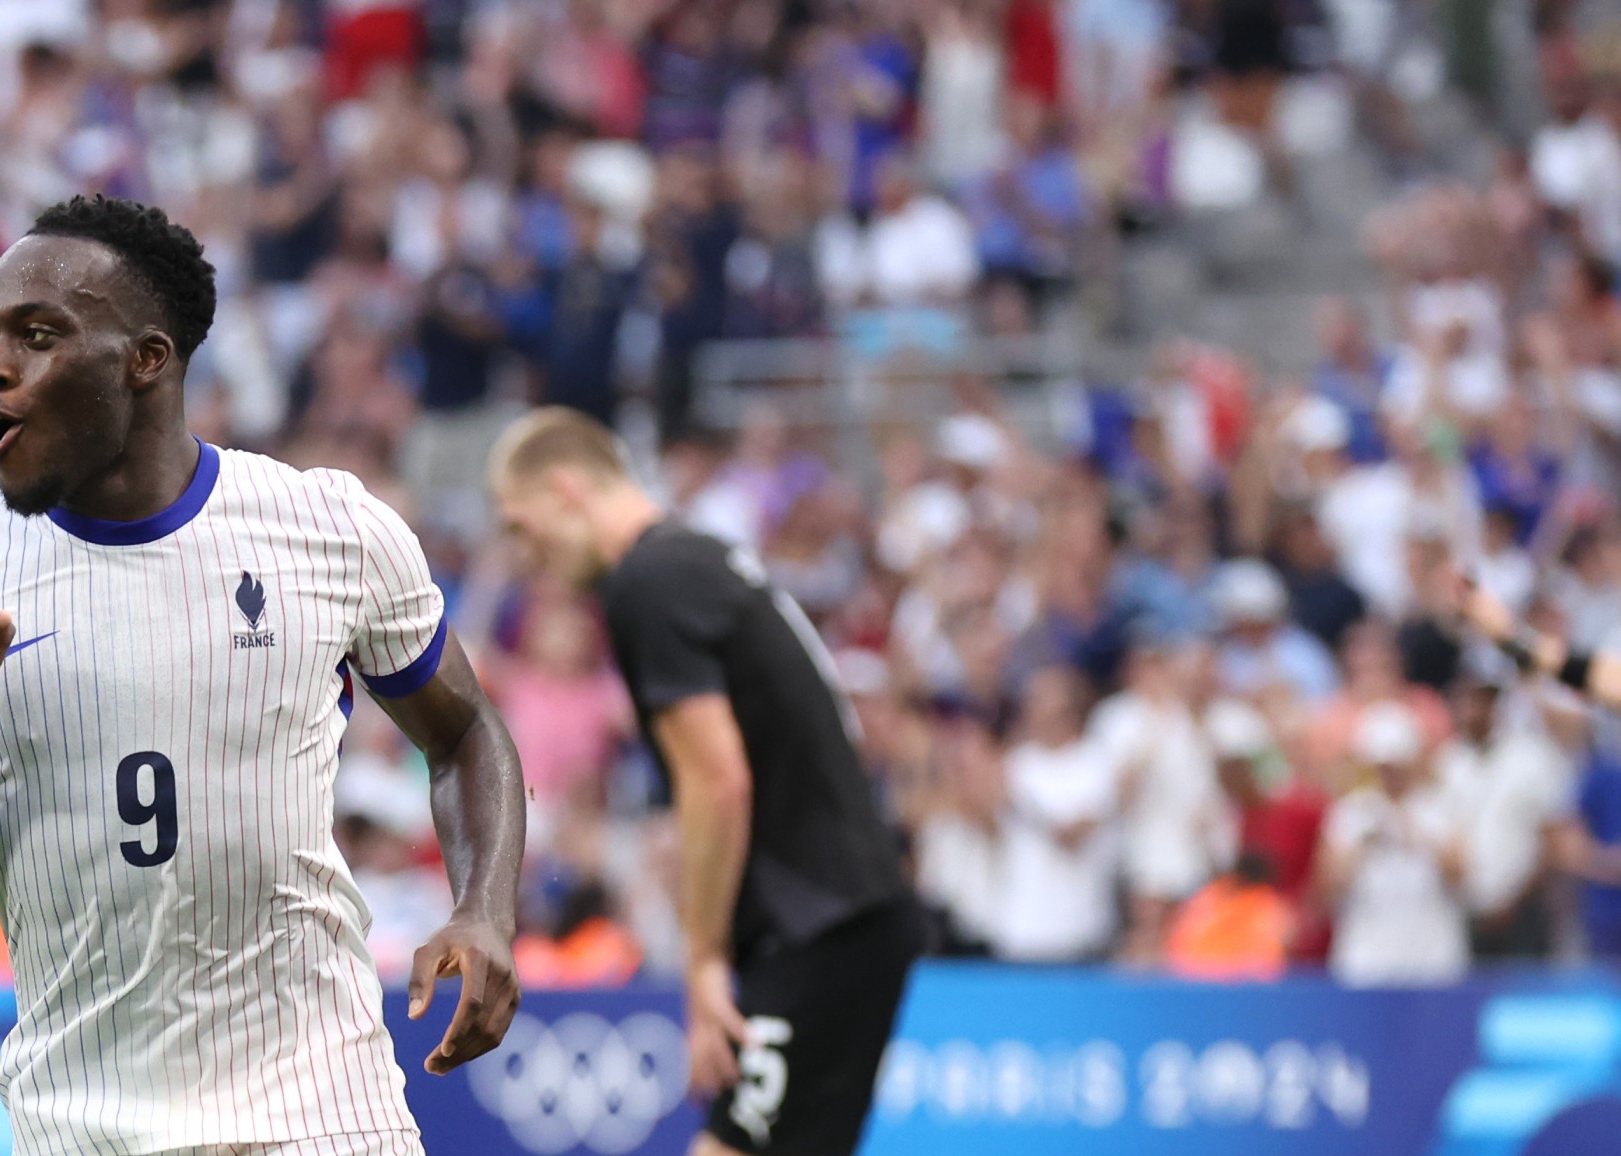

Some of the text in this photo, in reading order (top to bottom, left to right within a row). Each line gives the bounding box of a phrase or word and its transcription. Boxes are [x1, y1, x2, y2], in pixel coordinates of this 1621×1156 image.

[233, 632, 276, 649] FRANCE
[116, 750, 178, 868] 9
[876, 1037, 1370, 1130] PARIS 2024
